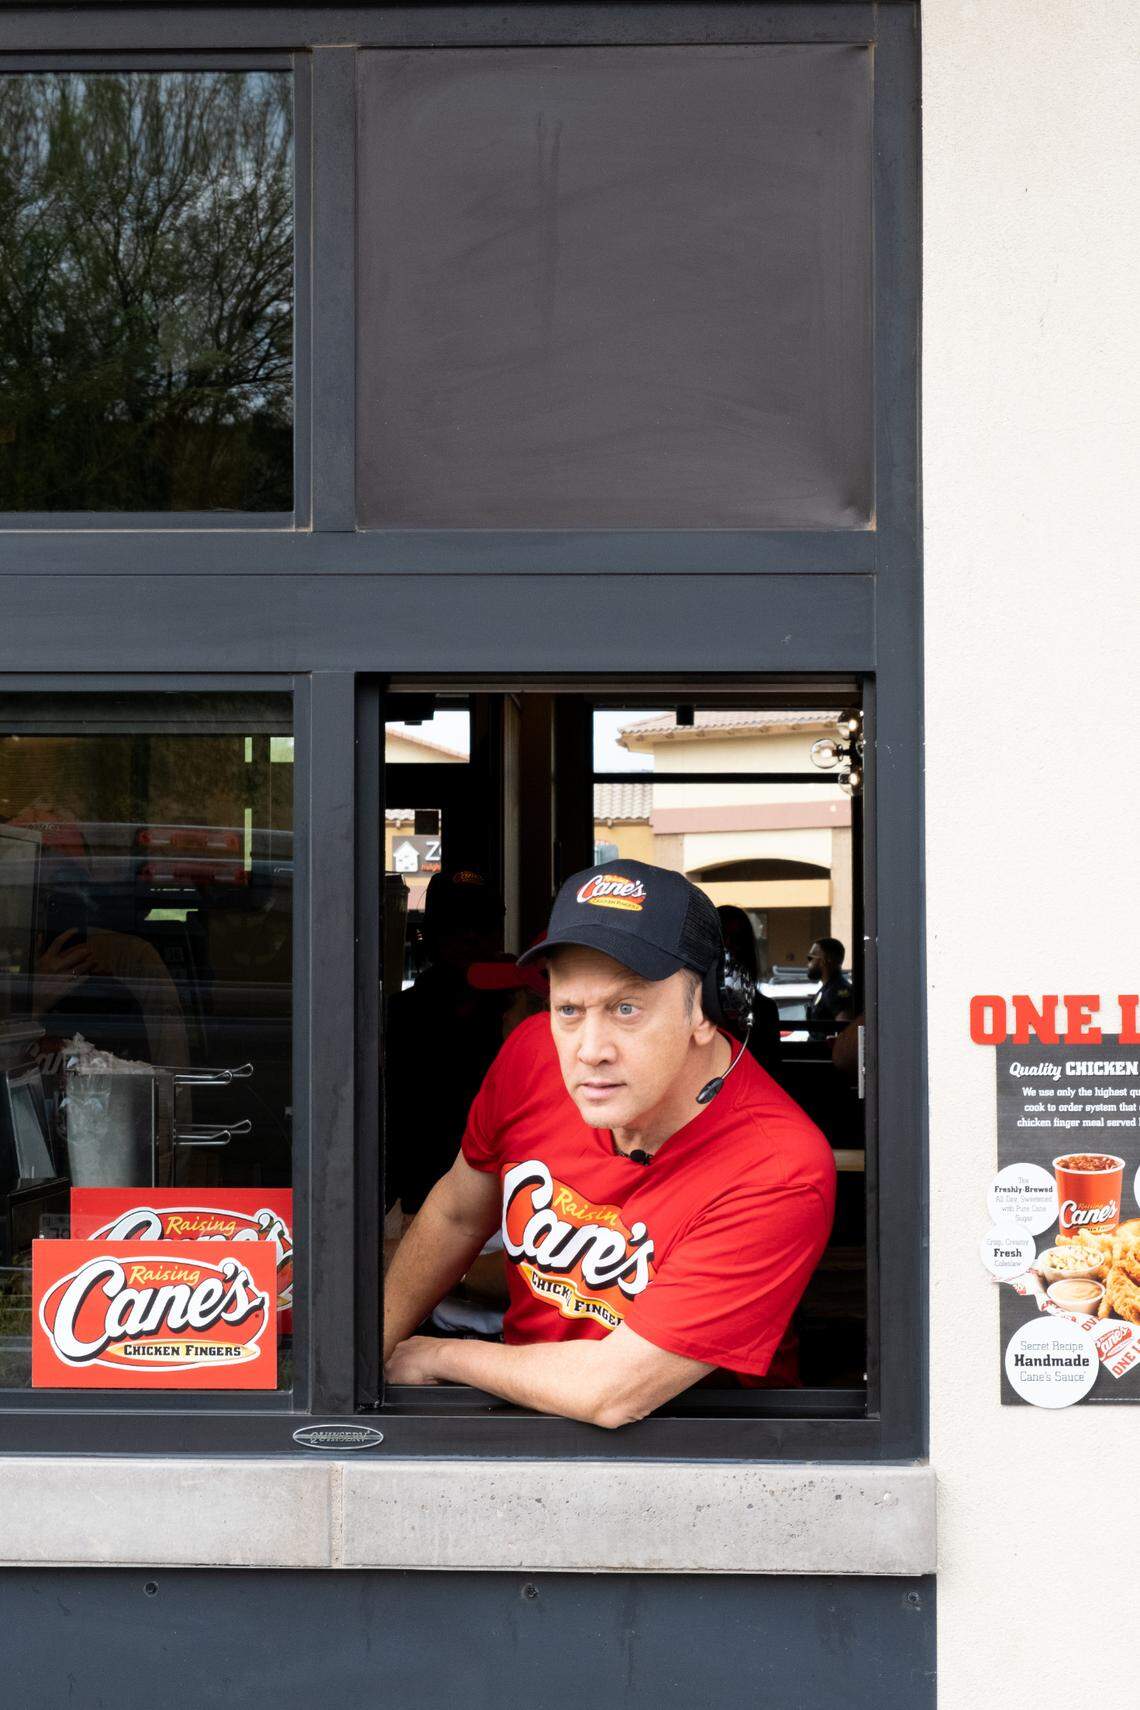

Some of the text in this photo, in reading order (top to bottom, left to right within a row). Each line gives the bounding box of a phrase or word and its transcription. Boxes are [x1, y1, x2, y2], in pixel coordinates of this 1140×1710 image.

[577, 875, 647, 903] Cane's
[970, 995, 1102, 1045] ONE
[1009, 1061, 1138, 1081] Quality CHICKEN
[1022, 1087, 1036, 1096] We
[1039, 1088, 1054, 1096] use
[1057, 1087, 1076, 1098] only
[1078, 1087, 1093, 1096] the
[1095, 1087, 1127, 1098] highest
[1024, 1102, 1136, 1113] cook to order system that
[1017, 1117, 1136, 1128] chicken finger meal served
[552, 1187, 620, 1226] Raisin
[1060, 1200, 1118, 1229] Cane's
[166, 1216, 237, 1236] Raising
[502, 1159, 655, 1298] Cane's
[994, 1248, 1022, 1257] Fresh
[128, 1265, 201, 1286] Raising
[53, 1259, 268, 1358] Cane's
[123, 1344, 242, 1357] CHICKEN FINGERS
[1020, 1341, 1084, 1352] Secret Recipe
[1014, 1354, 1090, 1366] Handmade
[1112, 1352, 1136, 1376] ONE
[1019, 1371, 1052, 1382] Cane's
